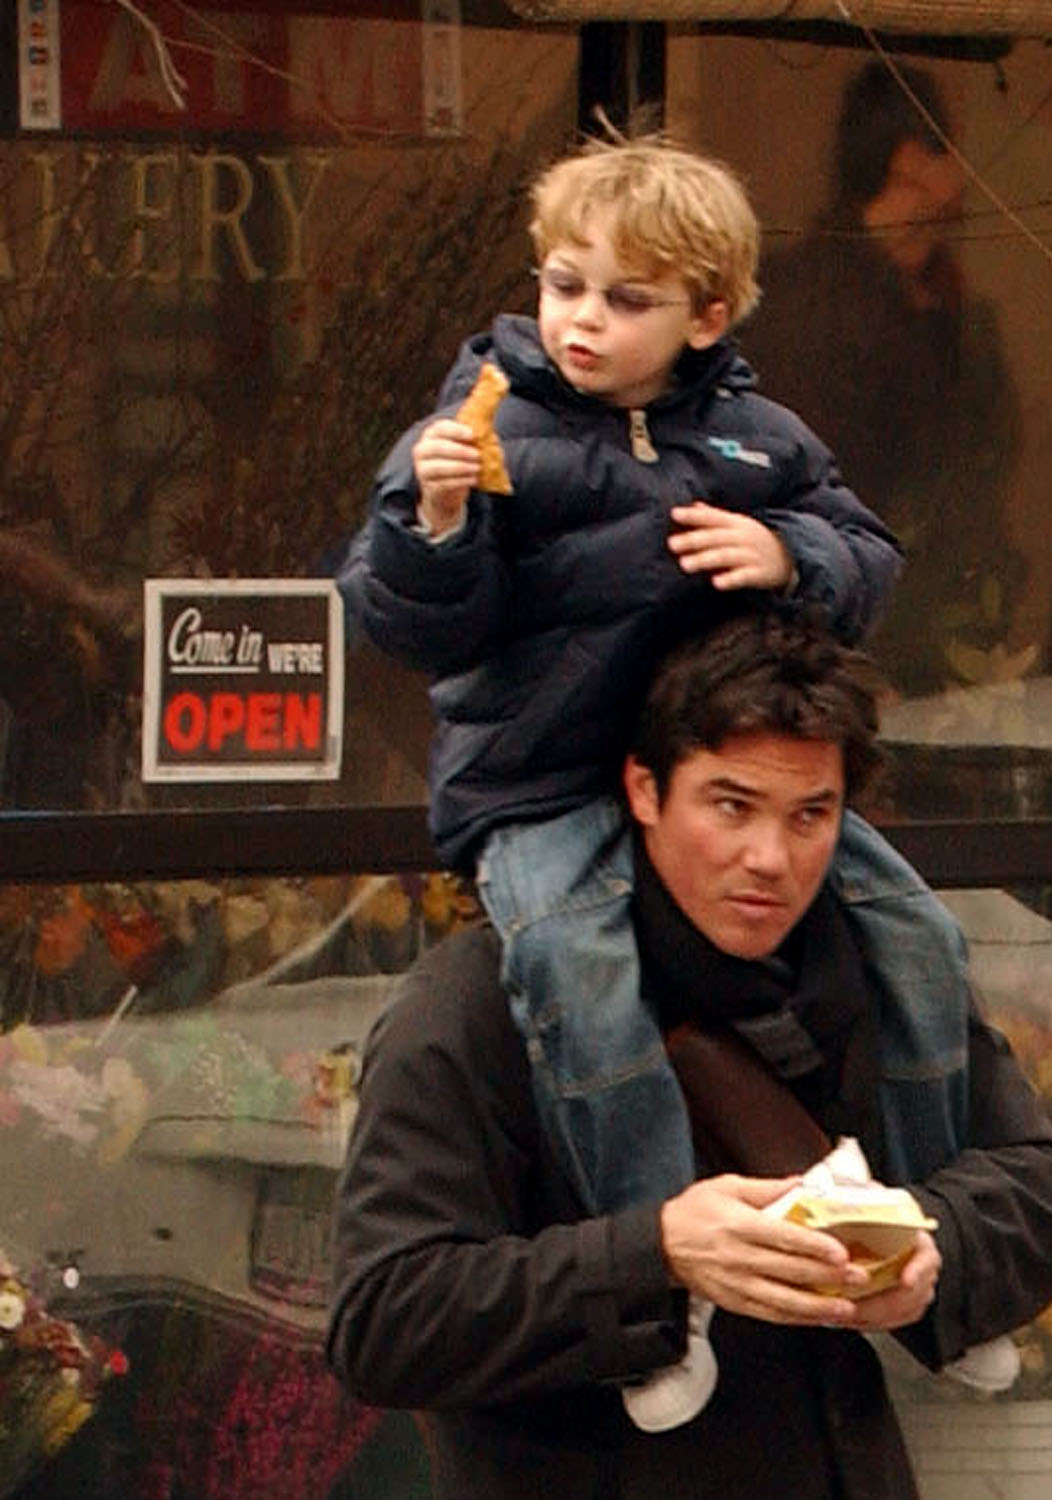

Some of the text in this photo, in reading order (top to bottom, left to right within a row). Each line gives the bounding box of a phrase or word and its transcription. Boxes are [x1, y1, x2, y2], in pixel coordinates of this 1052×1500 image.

[0, 154, 334, 282] KERY
[168, 608, 323, 674] Come in WE'RE
[164, 691, 322, 755] OPEN
